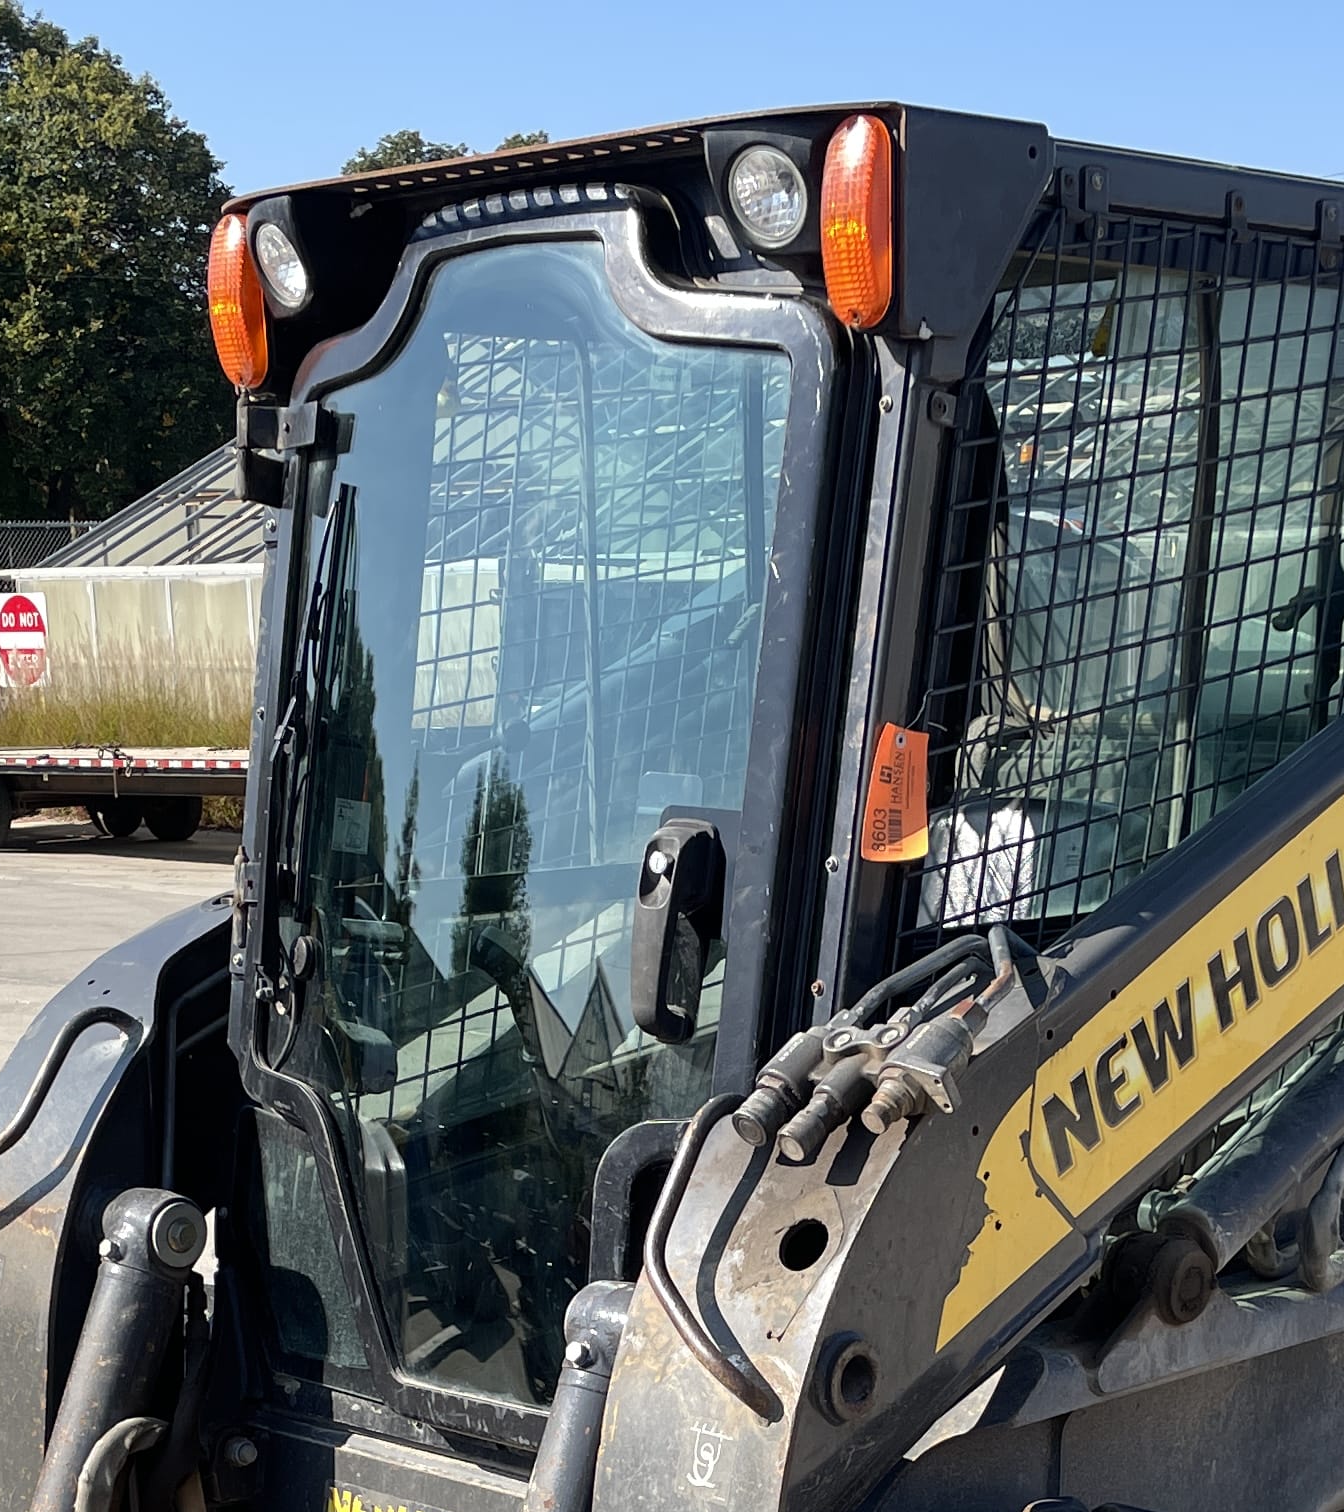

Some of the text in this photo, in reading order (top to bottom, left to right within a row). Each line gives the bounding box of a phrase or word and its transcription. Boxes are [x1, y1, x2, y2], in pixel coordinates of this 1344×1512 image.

[1, 612, 39, 628] DO NOT
[871, 808, 887, 852] 8603
[1041, 977, 1196, 1178] NEW
